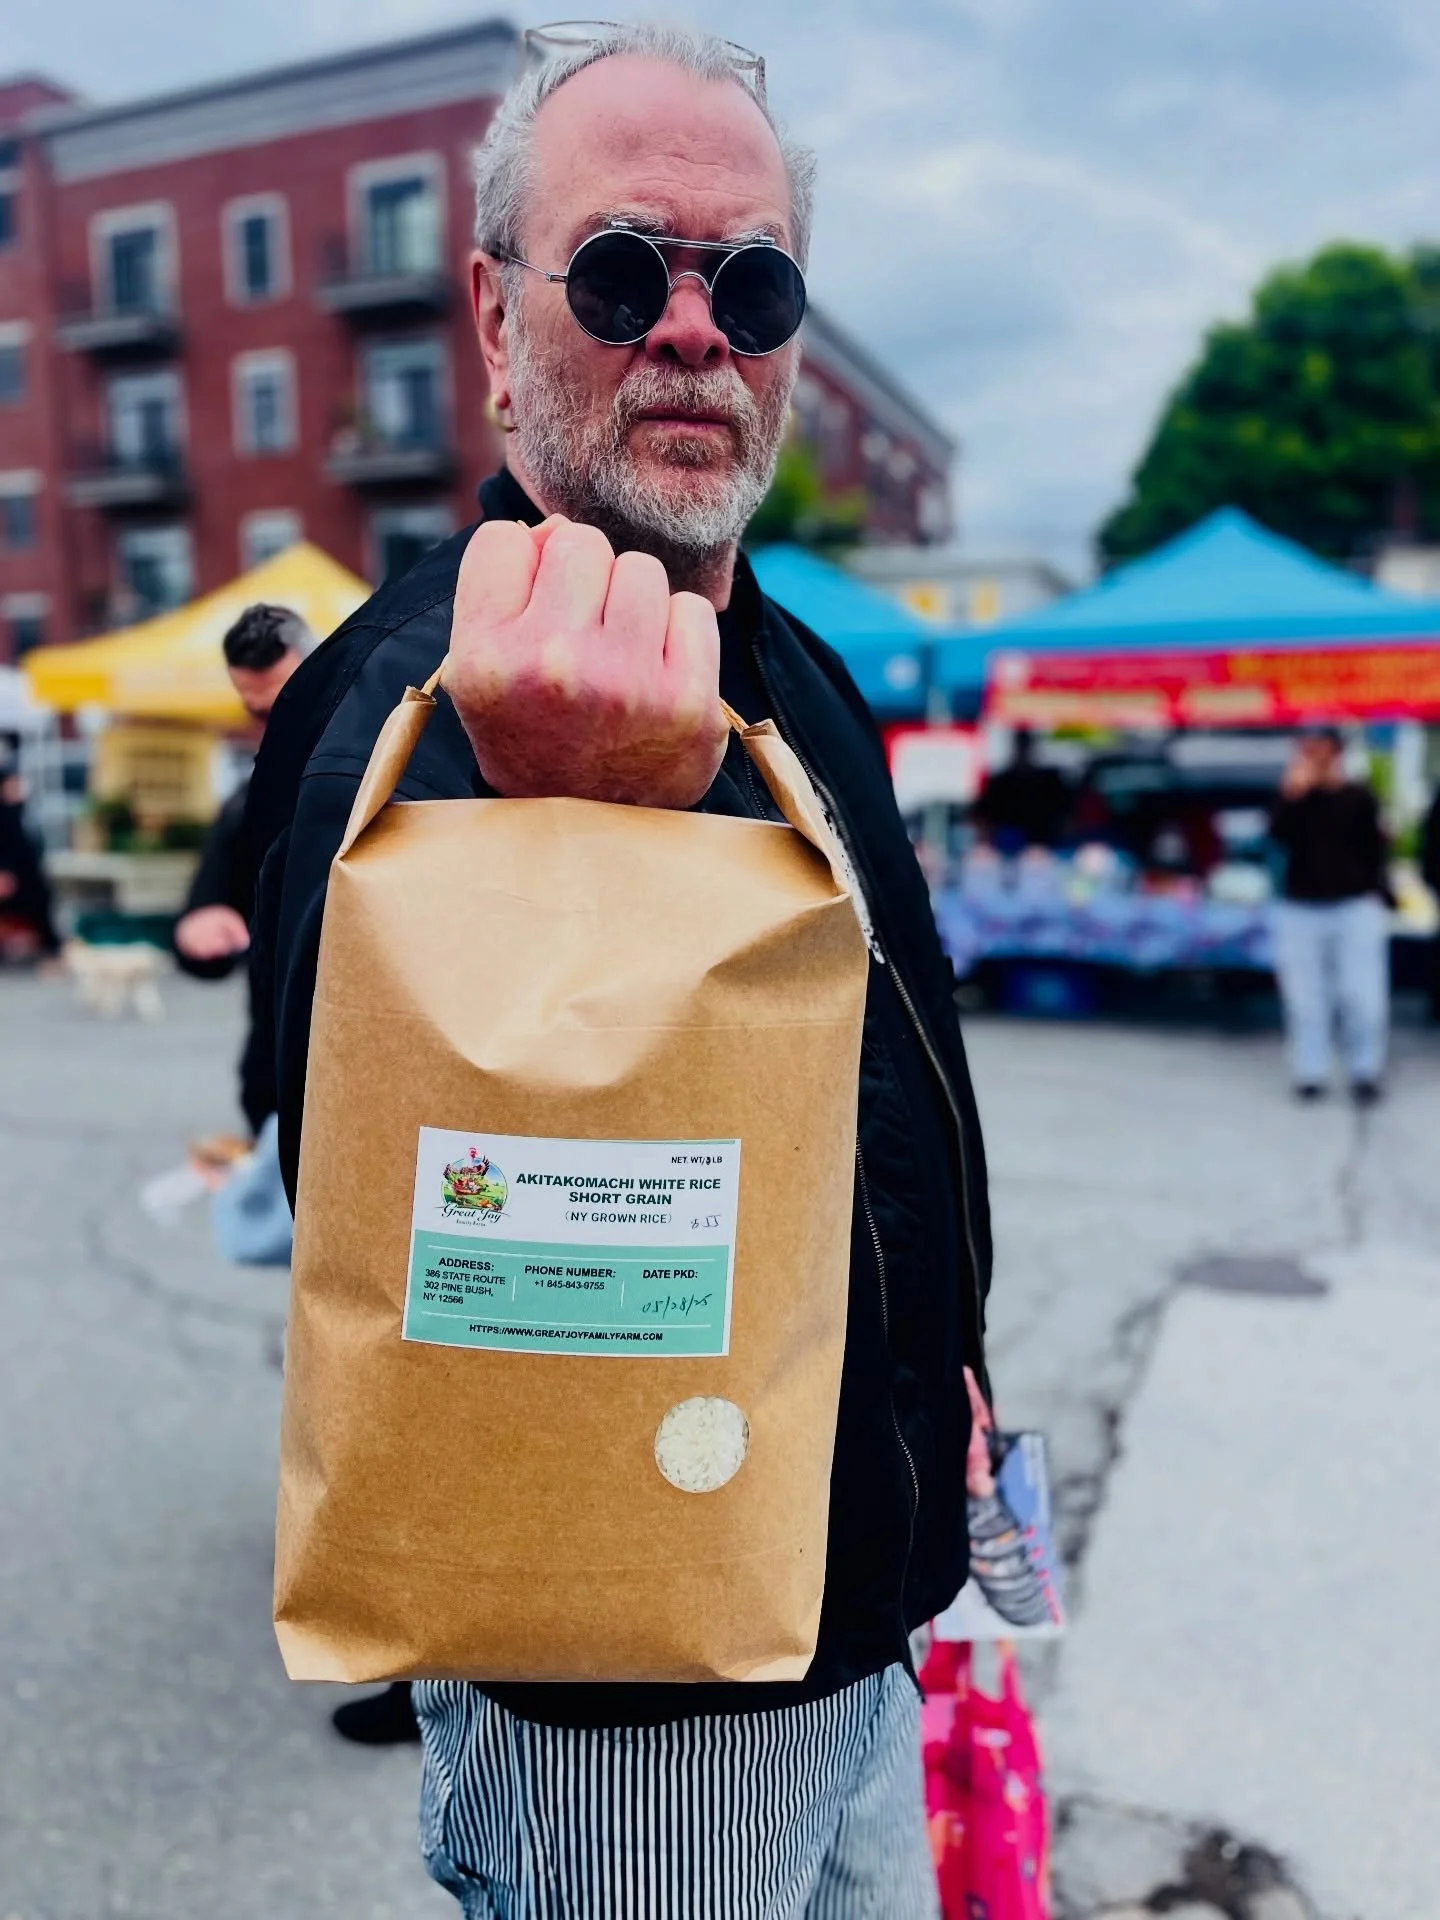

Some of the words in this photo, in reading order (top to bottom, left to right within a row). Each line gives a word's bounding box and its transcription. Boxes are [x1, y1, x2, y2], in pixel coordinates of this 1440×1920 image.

[516, 1173, 634, 1189] AKITAKOMACHI
[638, 1178, 686, 1190] WHITE
[689, 1178, 721, 1190] RICE
[568, 1191, 622, 1204] SHORT
[625, 1193, 672, 1205] GRAIN
[441, 1202, 477, 1218] Great
[476, 1207, 502, 1224] Joy
[591, 1212, 637, 1224] GROWN
[640, 1213, 672, 1225] RICE)
[438, 1257, 495, 1272] ADDRESS:
[425, 1268, 441, 1278] 386
[442, 1271, 471, 1282] STATE
[472, 1274, 506, 1285] ROUTE
[524, 1265, 563, 1276] PHONE
[566, 1267, 617, 1279] NUMBER:
[642, 1269, 671, 1279] DATE
[673, 1269, 699, 1279] PKD:
[423, 1280, 440, 1290] 302
[441, 1282, 463, 1293] PINE
[534, 1280, 545, 1288] +1
[546, 1279, 605, 1290] 845-843-9755
[423, 1292, 437, 1301] NY
[438, 1294, 464, 1305] 12566
[469, 1324, 664, 1341] HTTPS://WWW.GREATJOYFAMILYFARM.COM
